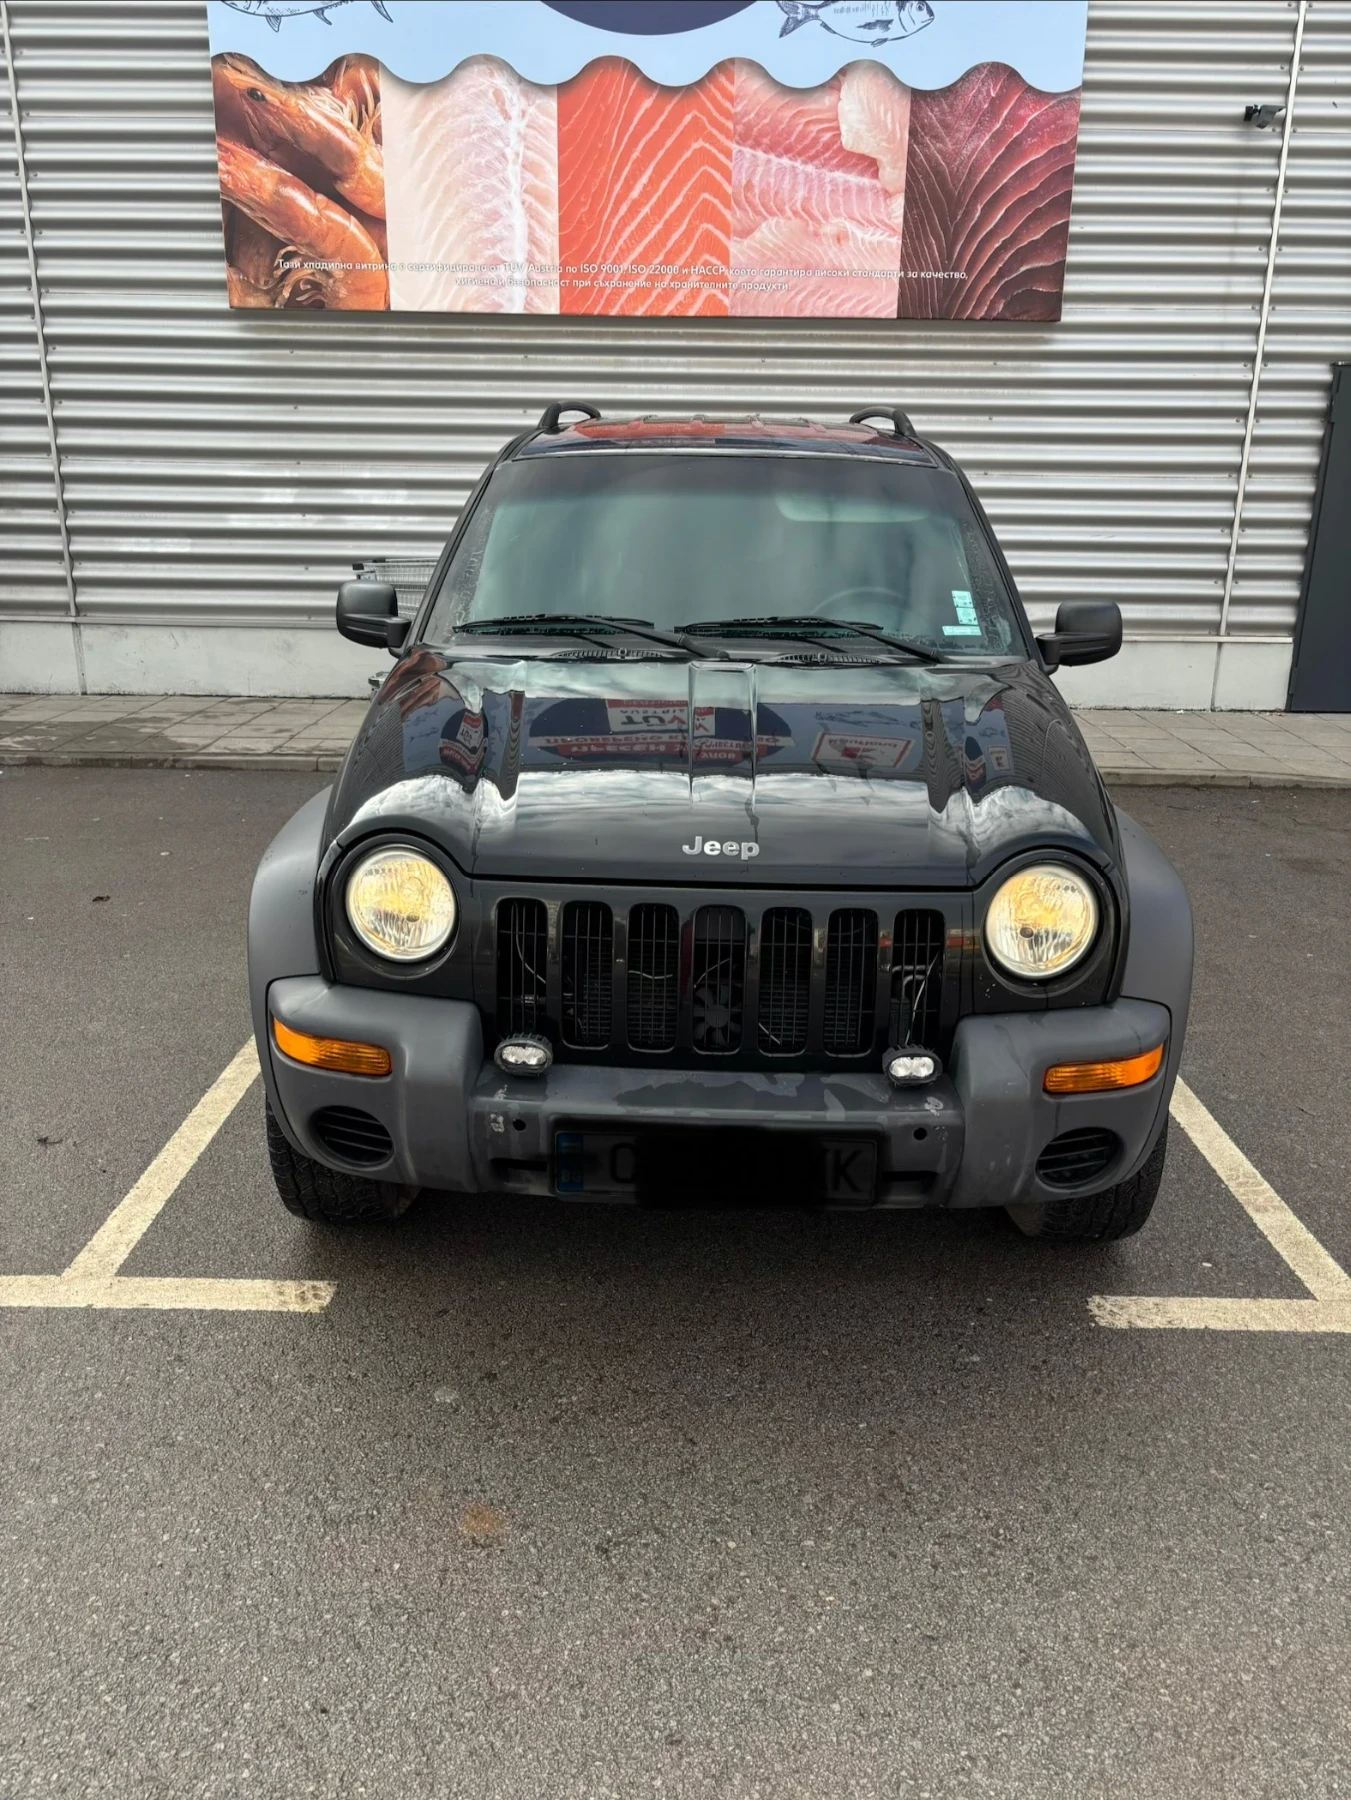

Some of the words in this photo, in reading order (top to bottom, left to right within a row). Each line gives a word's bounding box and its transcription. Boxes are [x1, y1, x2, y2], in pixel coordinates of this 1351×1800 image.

[279, 259, 301, 269] Тази
[303, 261, 353, 271] хладилна
[355, 262, 397, 272] витрина
[407, 263, 487, 273] сертифицирана
[489, 264, 500, 273] от
[528, 263, 562, 274] Austria
[565, 265, 577, 274] по
[580, 263, 598, 274] ISO
[600, 264, 626, 275] 9001,
[628, 264, 646, 275] ISO
[649, 265, 679, 275] 22000
[729, 267, 757, 277] което
[759, 268, 813, 279] гарантира
[815, 269, 850, 278] високи
[852, 269, 905, 280] стандарти
[906, 270, 918, 279] за
[920, 270, 968, 281] качество,
[455, 277, 496, 287] хигиена
[507, 275, 570, 288] безопасност
[572, 280, 591, 289] при
[593, 280, 652, 290] съхранение
[654, 281, 668, 290] на
[669, 281, 738, 291] хранителните
[682, 836, 760, 860] Jeep
